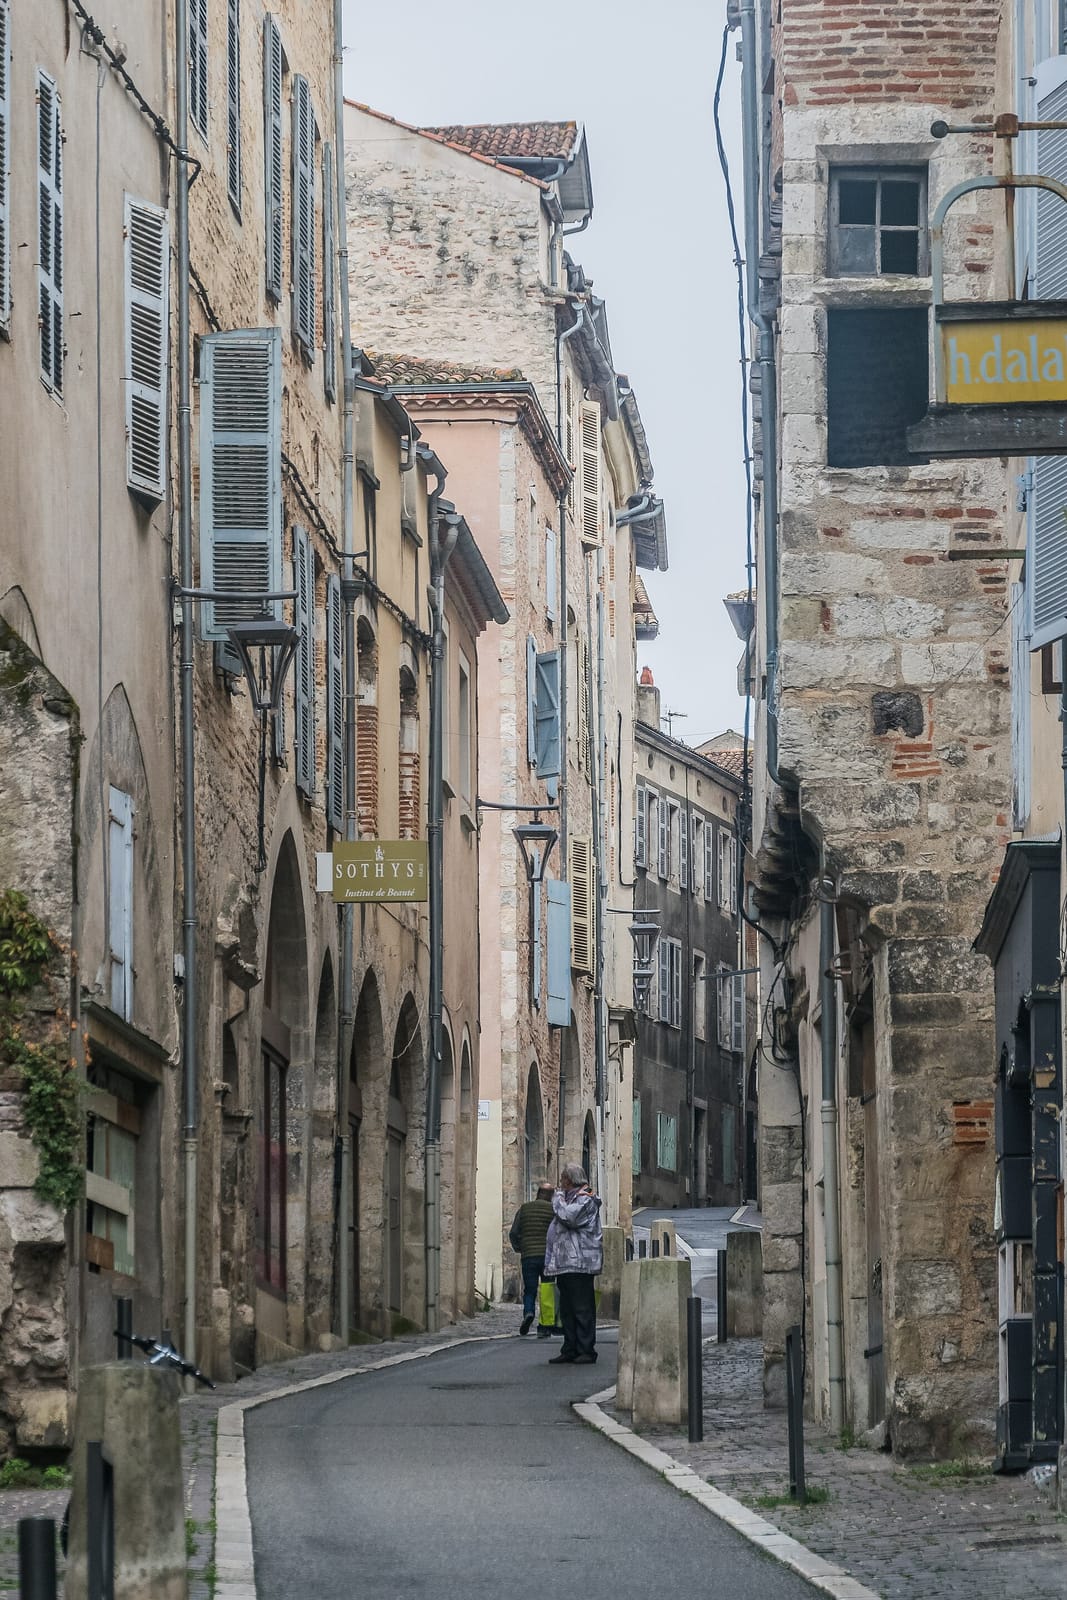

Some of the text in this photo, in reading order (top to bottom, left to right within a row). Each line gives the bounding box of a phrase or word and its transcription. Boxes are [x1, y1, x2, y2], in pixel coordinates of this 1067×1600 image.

[948, 333, 1067, 385] h.dala
[335, 863, 414, 879] SOTHYS
[345, 888, 416, 897] Institut de Beauté
